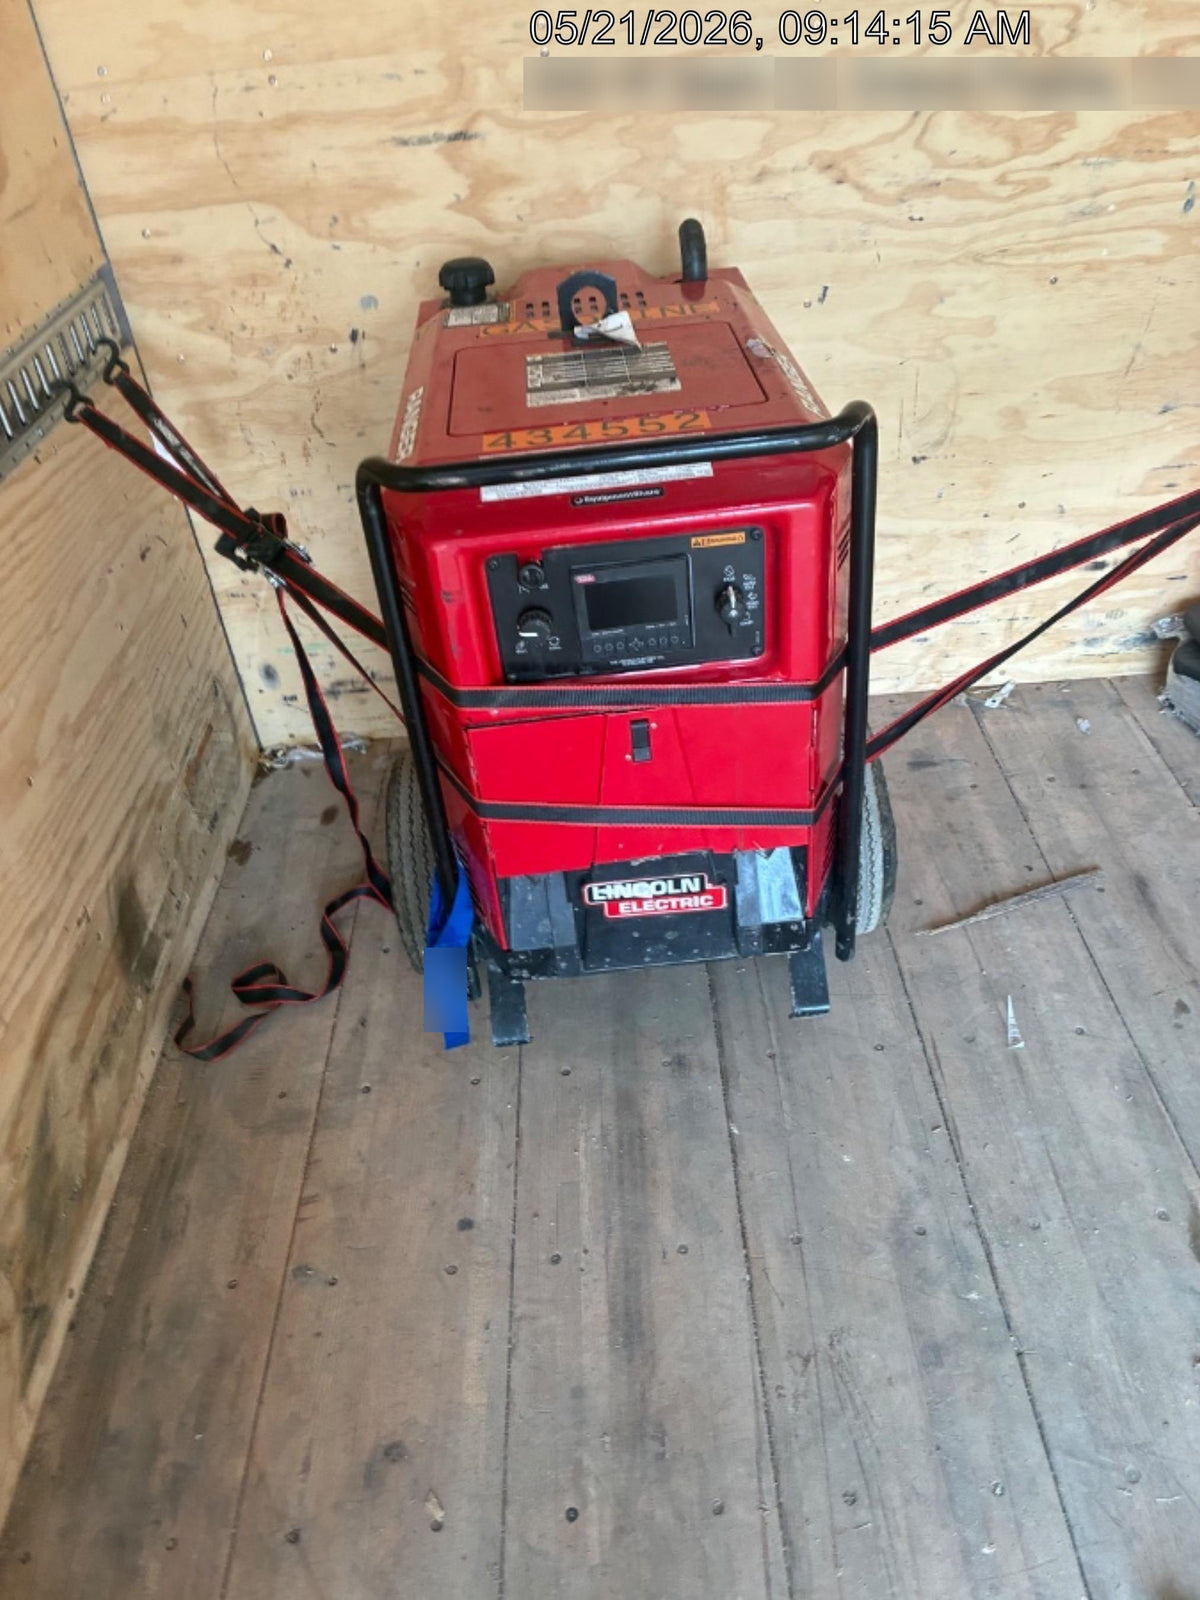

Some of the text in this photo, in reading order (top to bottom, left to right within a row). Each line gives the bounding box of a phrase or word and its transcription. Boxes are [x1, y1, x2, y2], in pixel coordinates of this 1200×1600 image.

[488, 412, 705, 449] 434552
[592, 877, 700, 901] LINCOLN
[618, 894, 714, 914] ELECTRIC
